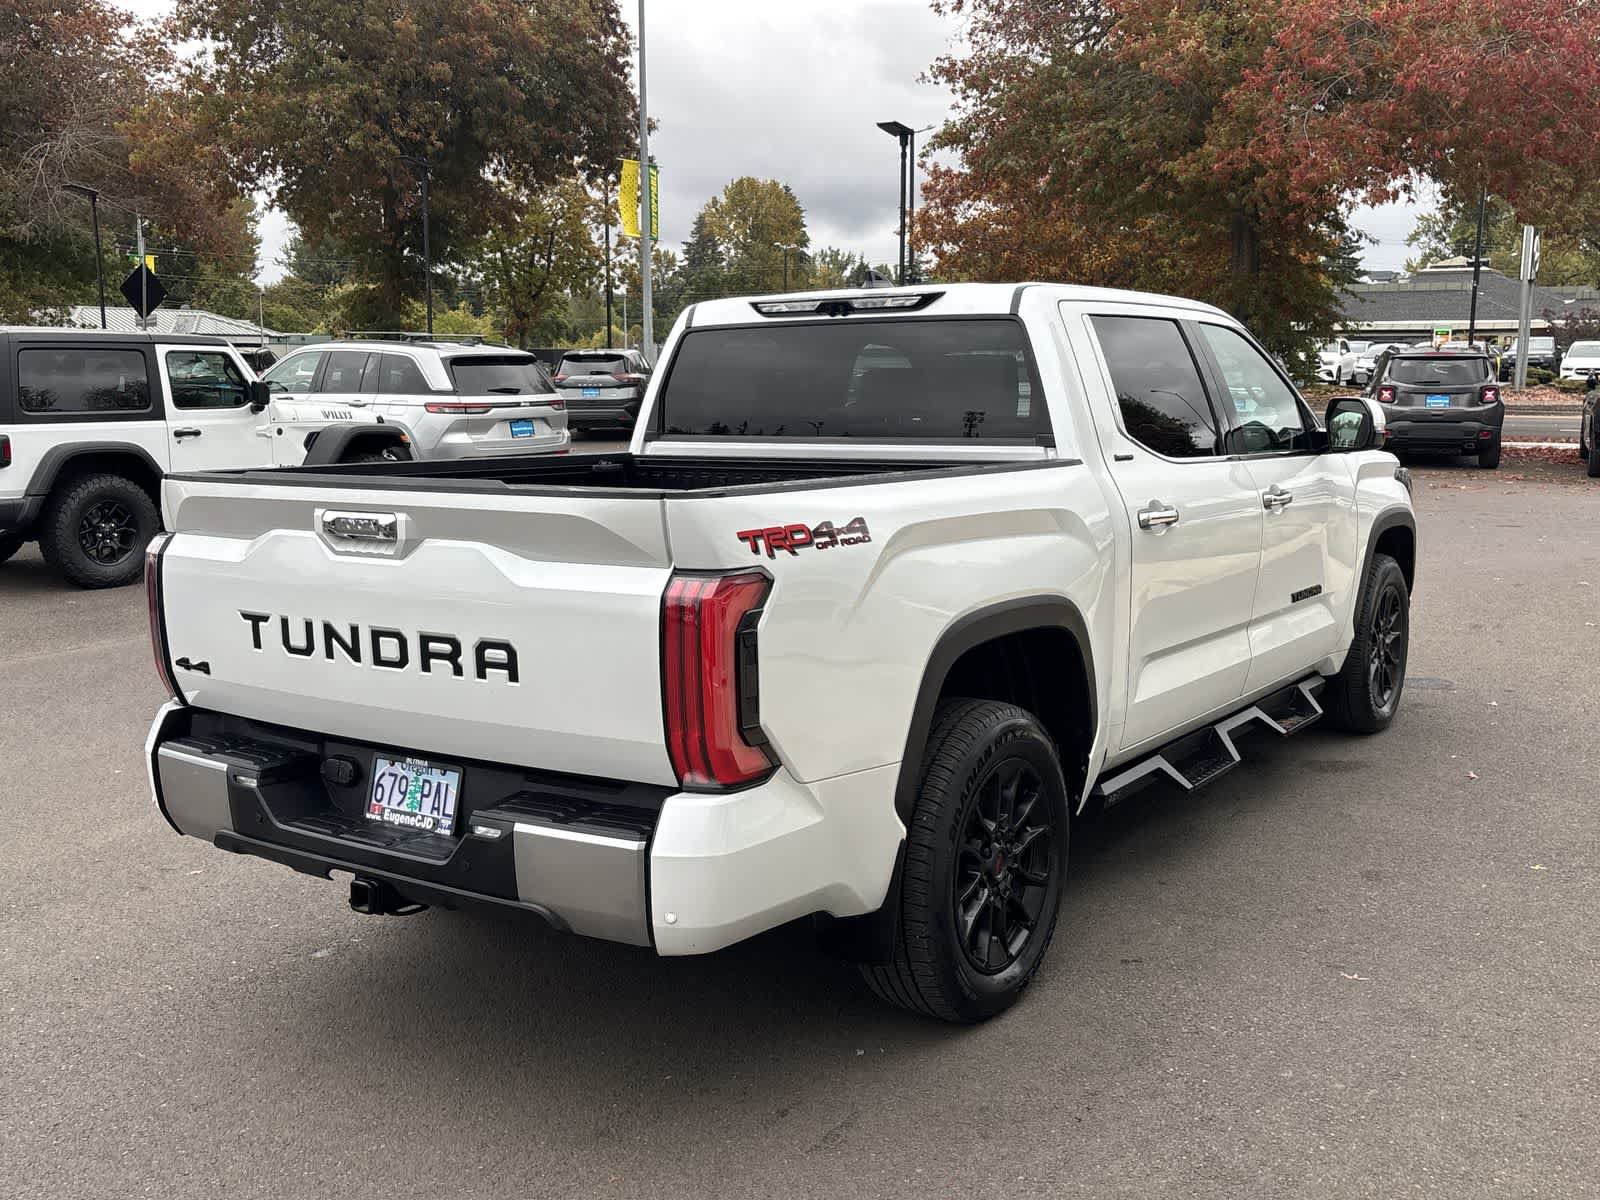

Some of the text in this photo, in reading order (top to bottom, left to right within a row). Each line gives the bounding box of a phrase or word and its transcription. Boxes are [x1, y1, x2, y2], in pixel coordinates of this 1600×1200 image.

[649, 168, 658, 238] UNSTOPPABLE
[321, 409, 353, 420] WILLYS
[736, 523, 815, 560] TRD
[815, 535, 872, 550] OFF ROAD
[239, 610, 520, 685] TUNDRA
[374, 771, 452, 817] 679 PAL
[383, 808, 434, 829] EugeneCJD
